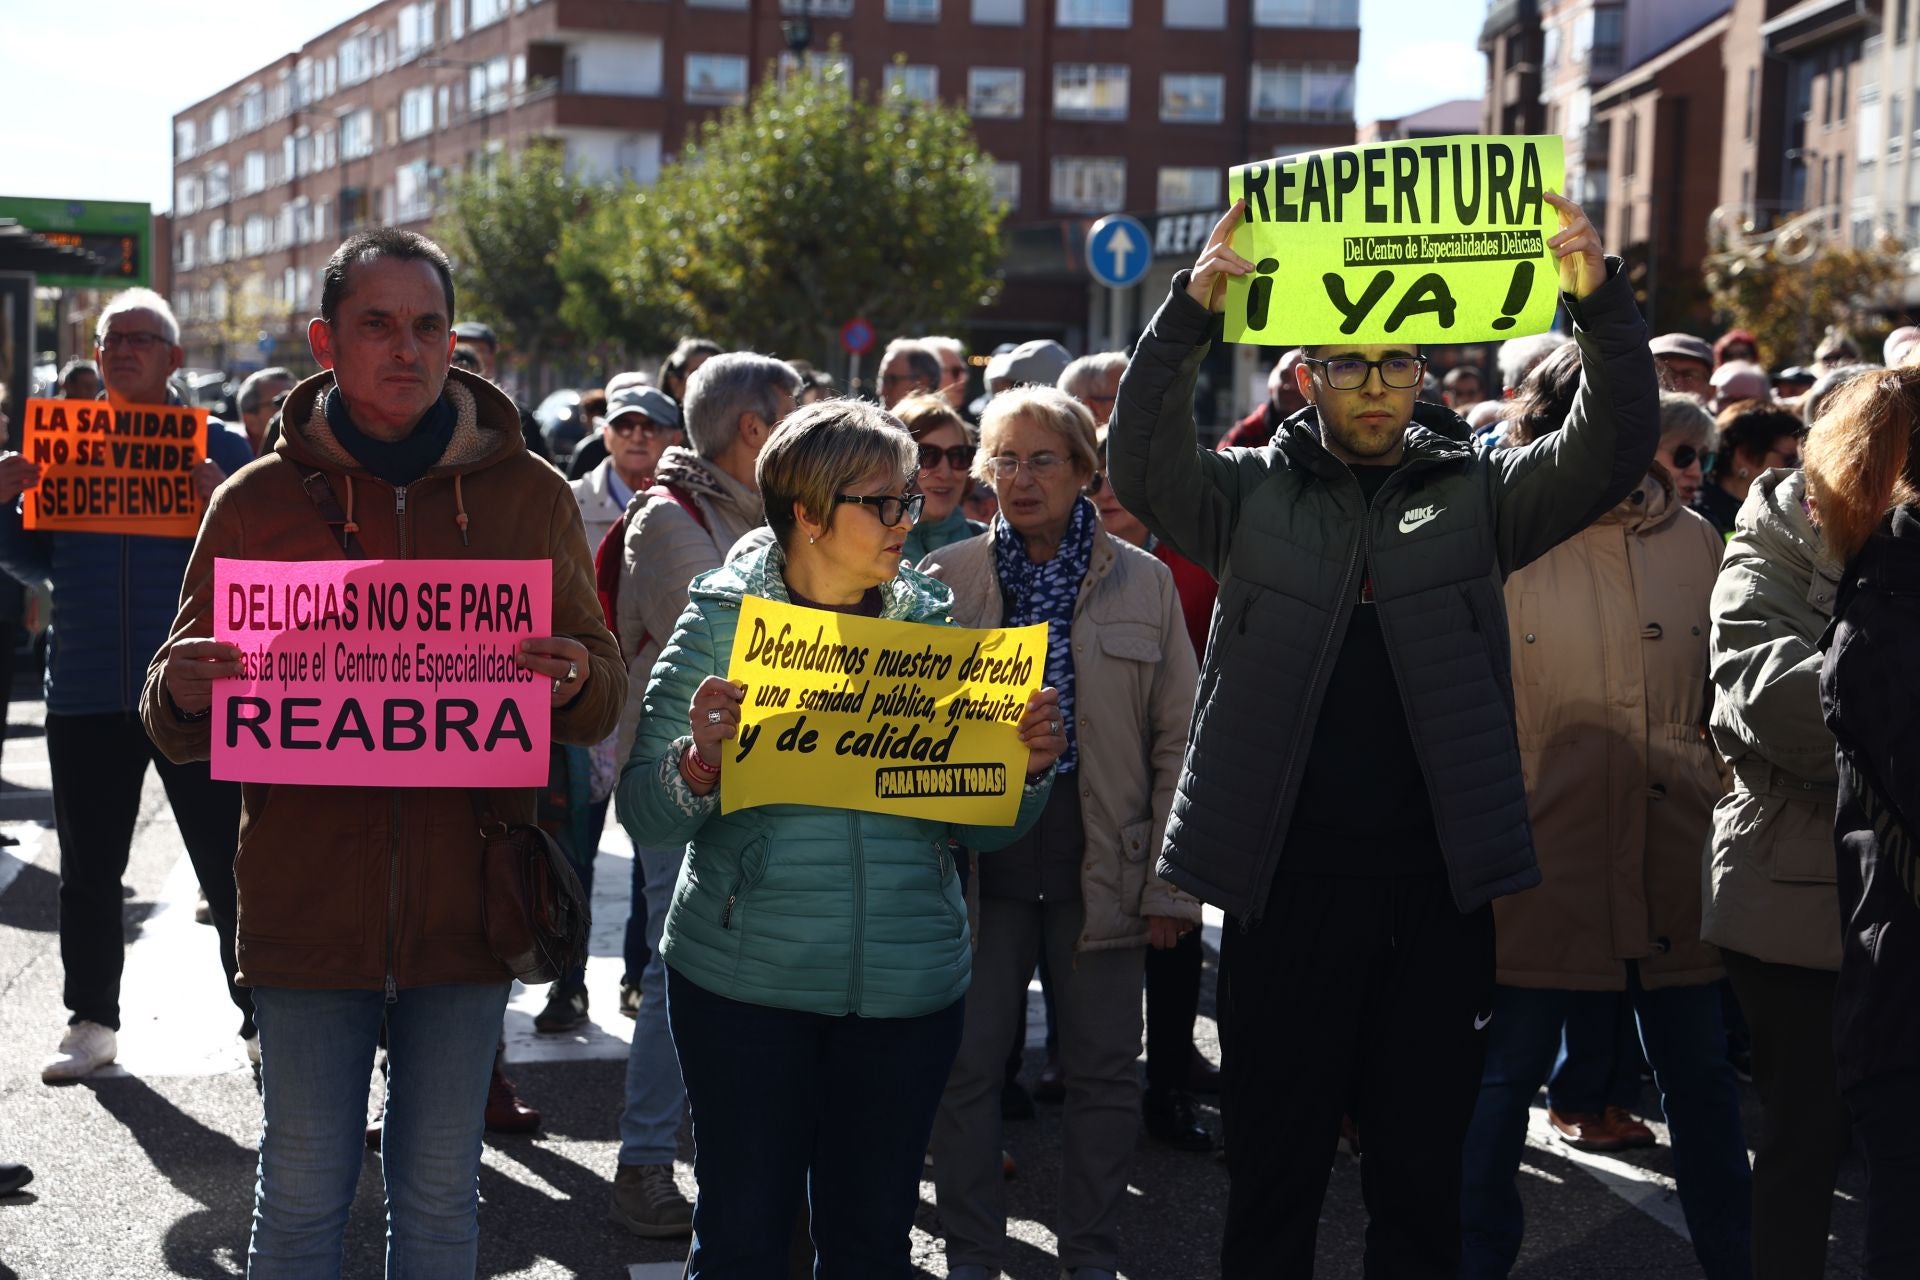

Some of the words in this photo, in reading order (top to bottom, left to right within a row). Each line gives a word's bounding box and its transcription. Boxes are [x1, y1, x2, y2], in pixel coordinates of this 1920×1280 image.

[1243, 142, 1543, 226] REAPERTURA
[1345, 238, 1364, 261] Del
[1366, 236, 1403, 260] Centro
[1405, 236, 1418, 259] de
[1420, 233, 1499, 263] Especialidades
[1501, 231, 1542, 255] Delicias
[1322, 269, 1457, 335] YA
[34, 407, 69, 432] LA
[77, 408, 198, 440] SANIDAD
[34, 438, 69, 465] NO
[76, 439, 106, 467] SE
[111, 441, 197, 473] VENDE
[34, 477, 69, 519] ¡SE
[73, 475, 196, 516] DEFIENDE!
[1404, 504, 1434, 522] NIKE
[228, 583, 359, 632] DELICIAS
[367, 582, 409, 632] NO
[416, 583, 452, 632] SE
[460, 583, 533, 633] PARA
[227, 643, 273, 682] asta
[278, 652, 308, 692] que
[312, 642, 326, 682] el
[335, 641, 388, 683] Centro
[391, 643, 411, 683] de
[745, 617, 869, 675] Defendamos
[873, 644, 953, 681] nuestro
[957, 641, 1033, 686] derecho
[226, 696, 533, 752] REABRA
[755, 685, 791, 708] una
[795, 679, 870, 714] sanidad
[867, 683, 937, 724] pública,
[944, 692, 1025, 728] gratuita
[736, 723, 762, 763] y
[776, 715, 819, 753] de
[834, 722, 960, 763] calidad
[877, 770, 915, 798] ¡PARA
[916, 768, 952, 794] TODOS
[953, 768, 962, 793] Y
[963, 767, 1005, 793] TODAS!
